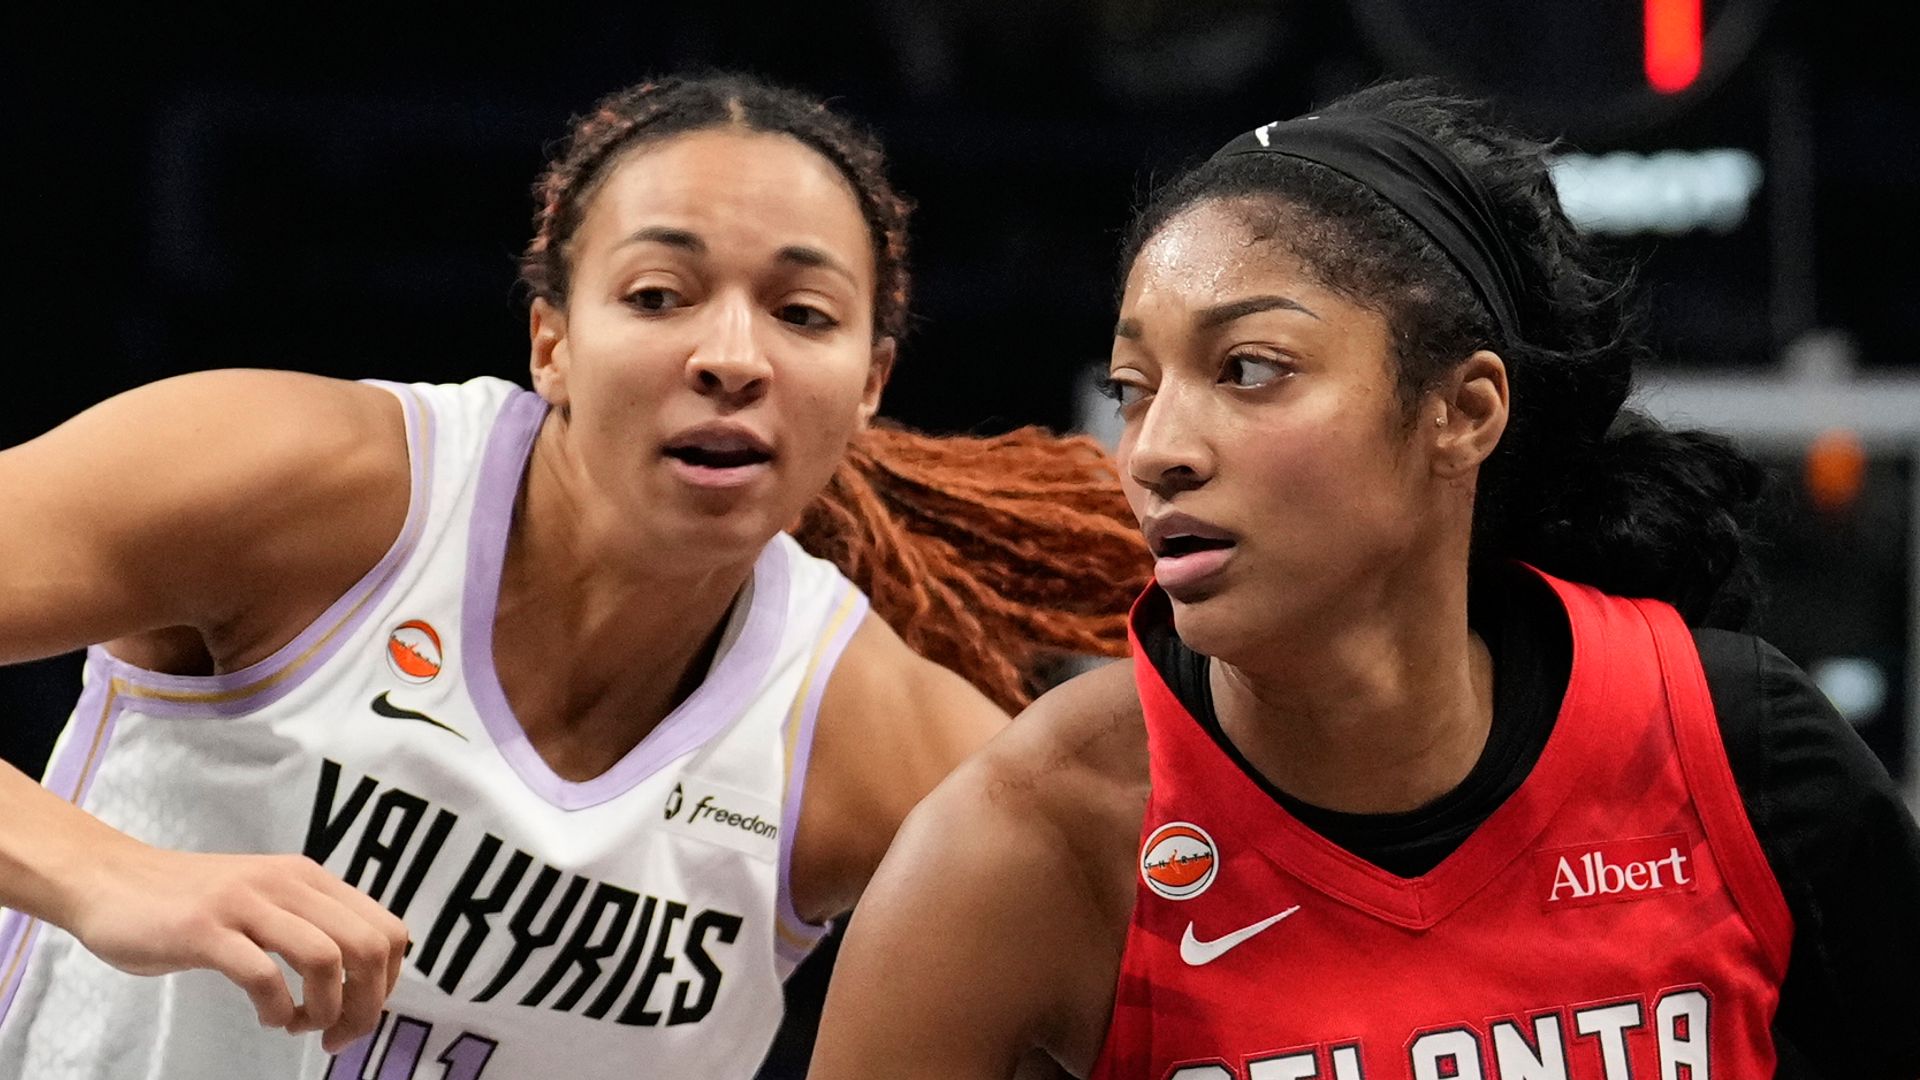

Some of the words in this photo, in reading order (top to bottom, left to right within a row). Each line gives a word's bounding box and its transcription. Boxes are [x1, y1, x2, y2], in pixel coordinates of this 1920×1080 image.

[687, 796, 778, 840] freedom
[302, 758, 743, 1027] VALKYRIES
[1547, 847, 1690, 902] Albert
